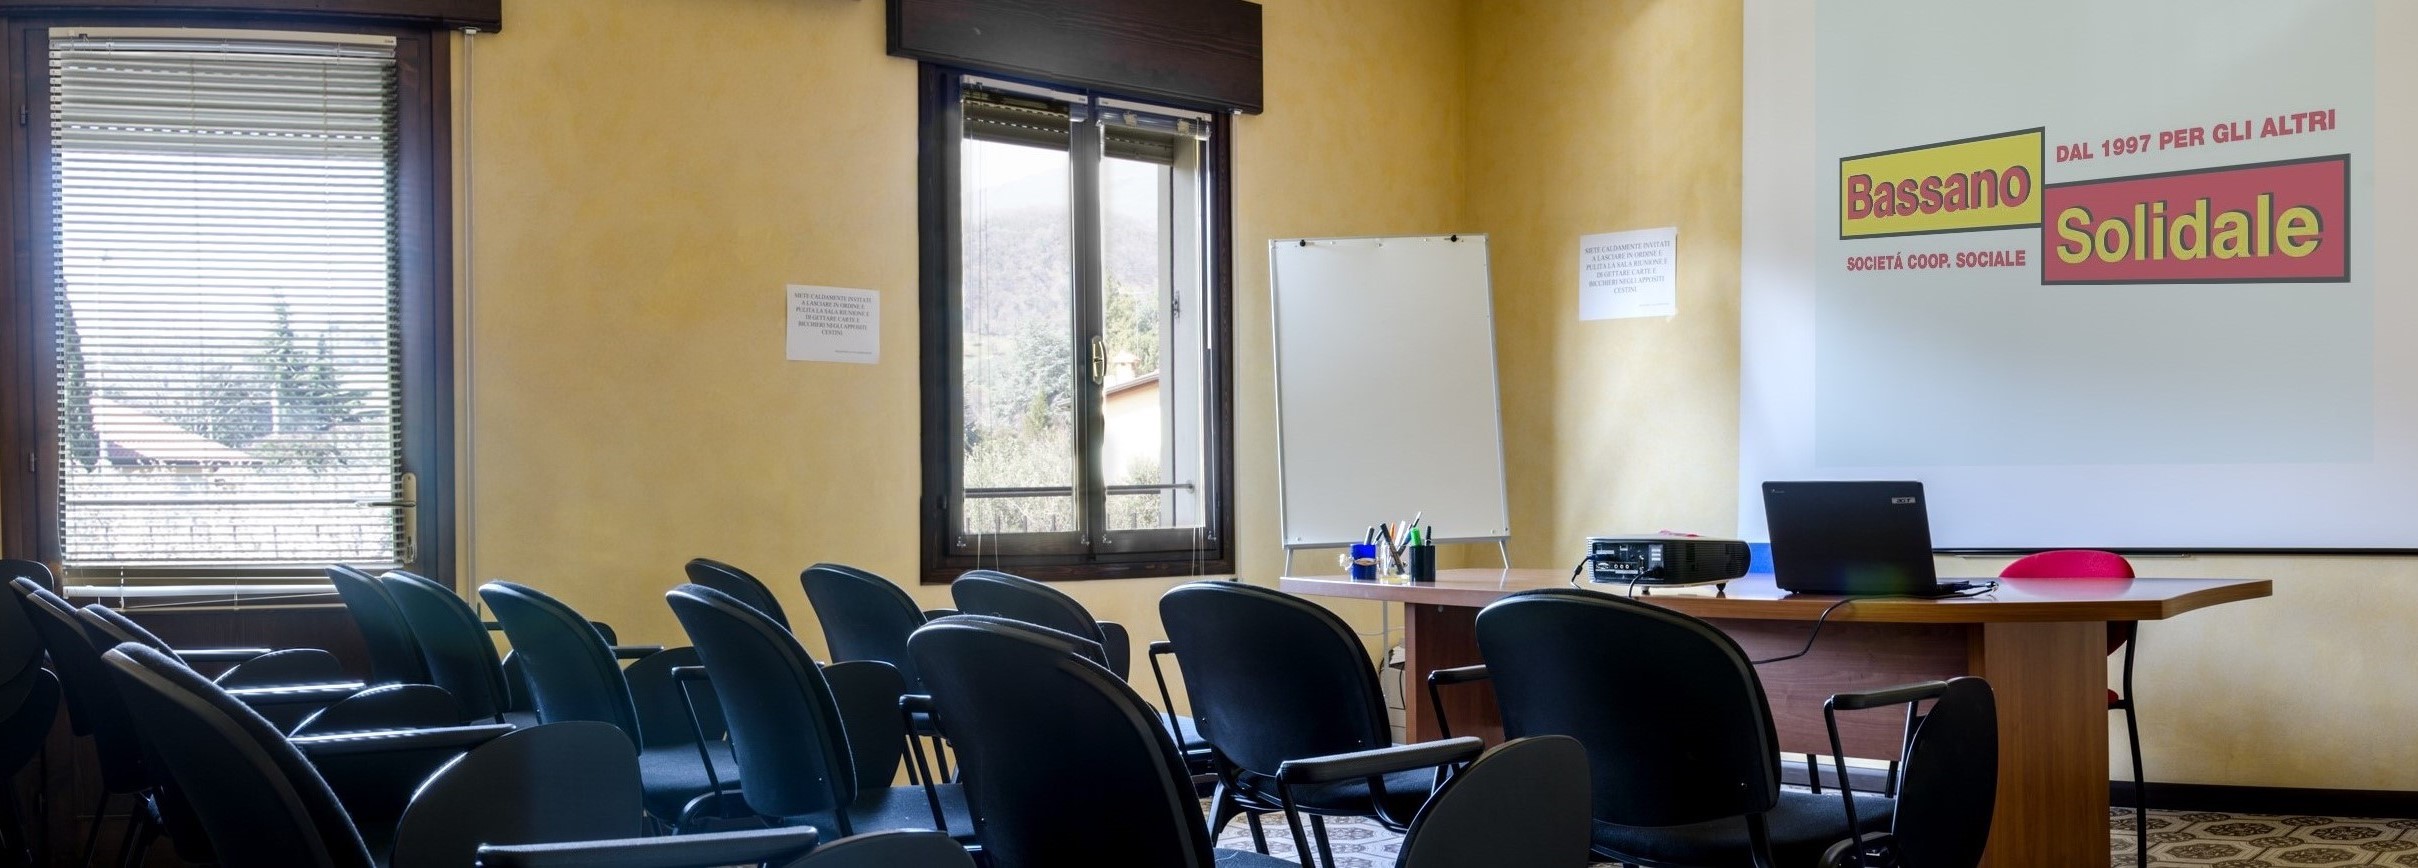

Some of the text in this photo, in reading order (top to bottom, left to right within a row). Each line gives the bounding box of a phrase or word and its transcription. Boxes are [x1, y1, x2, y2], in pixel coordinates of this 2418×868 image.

[2056, 109, 2336, 163] DAL 1997 PER GLI ALTRI
[1847, 164, 2032, 221] Bassano
[2056, 191, 2324, 265] Solidale
[1847, 250, 2026, 271] SOCIETÁ COOP. SOCIALE
